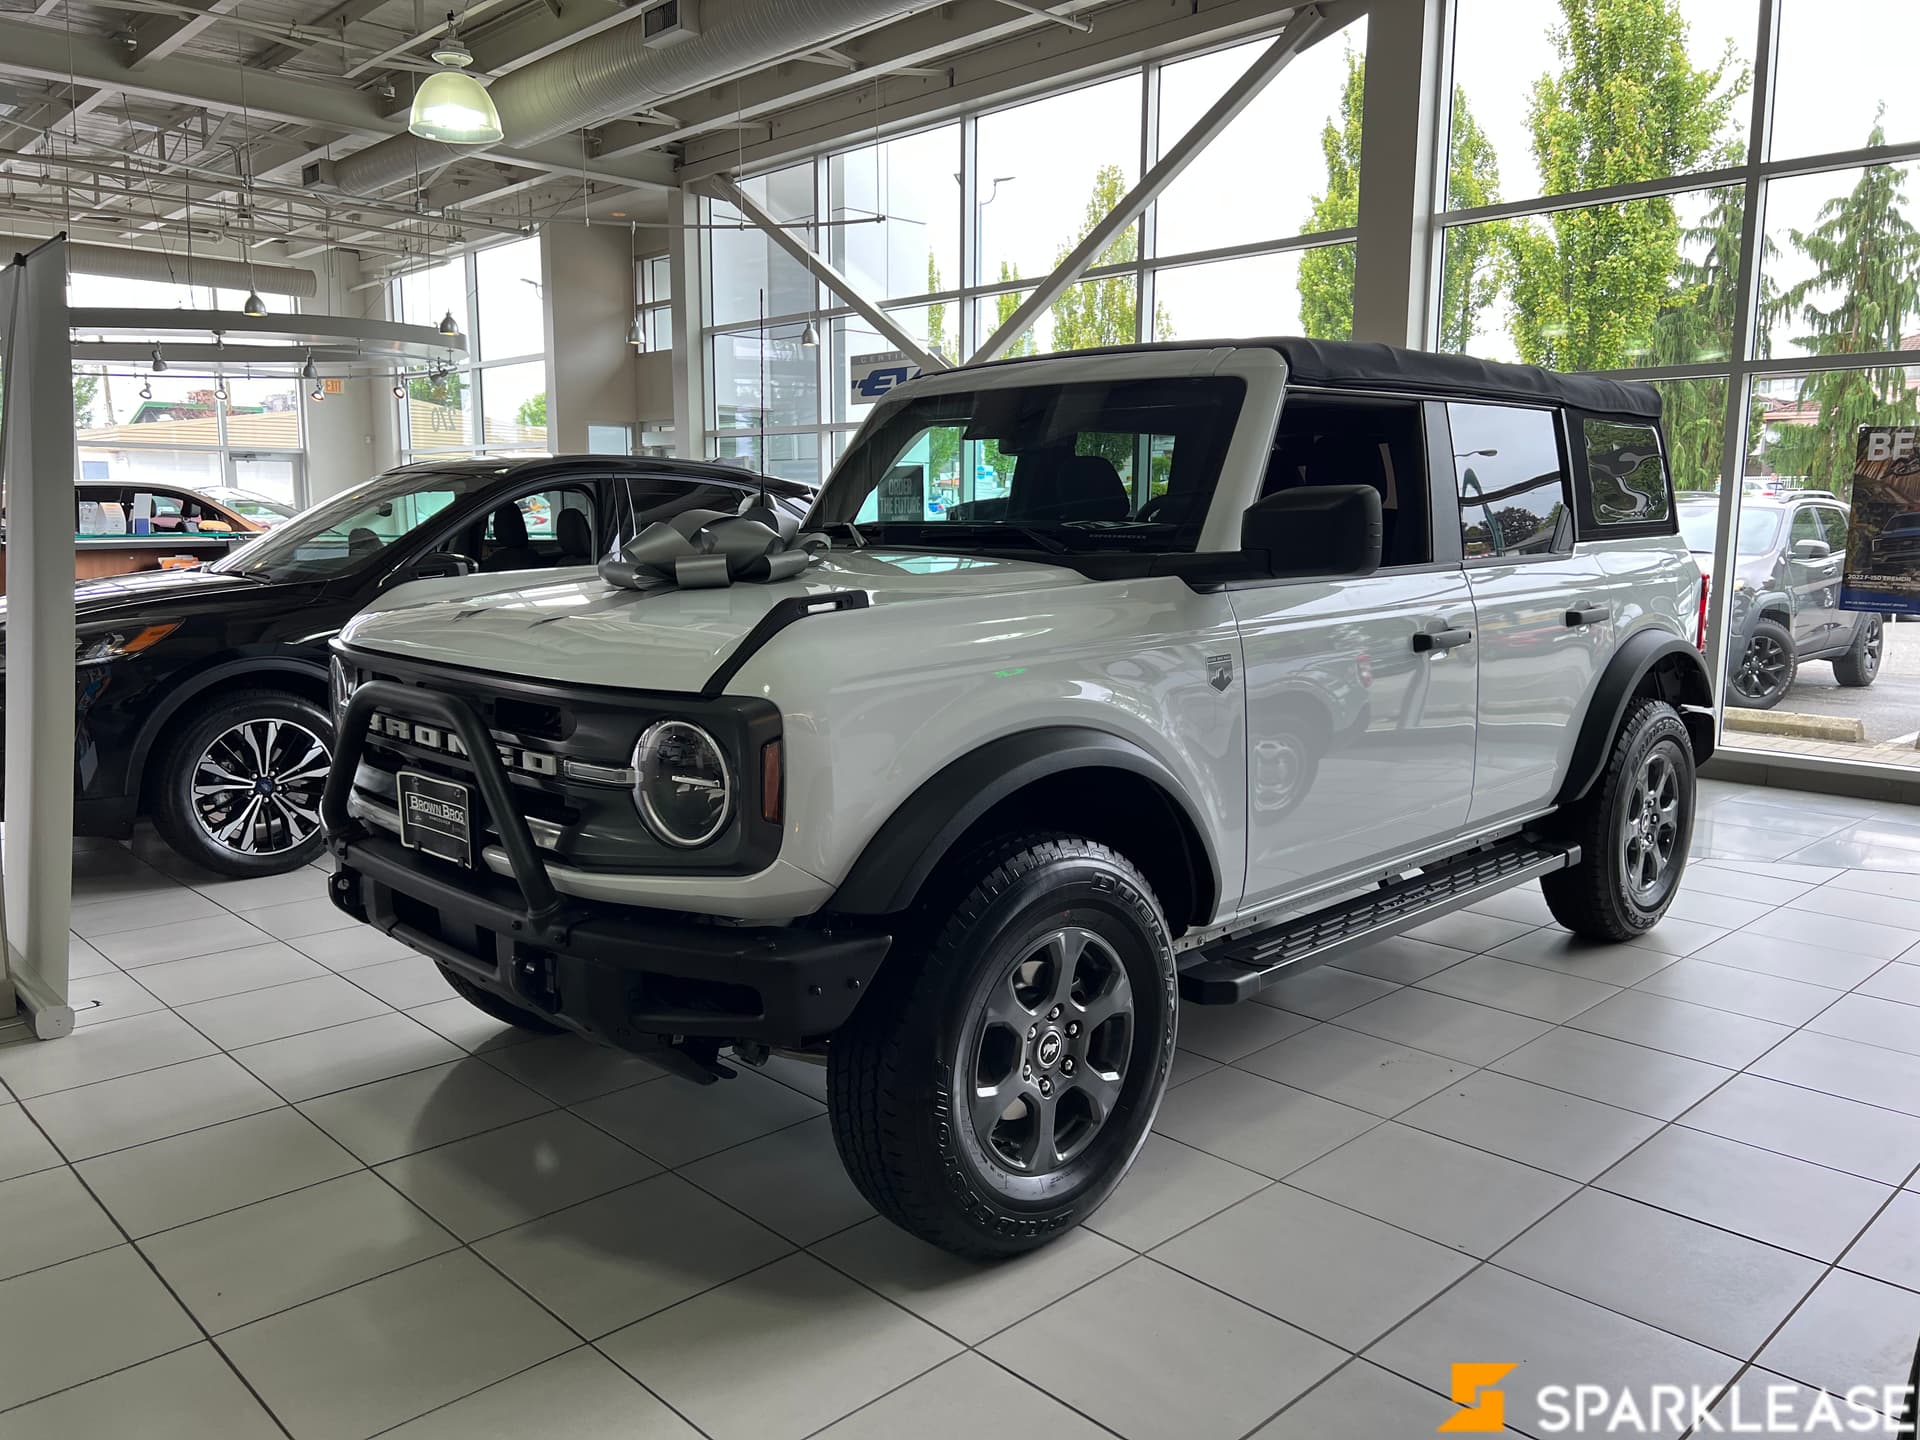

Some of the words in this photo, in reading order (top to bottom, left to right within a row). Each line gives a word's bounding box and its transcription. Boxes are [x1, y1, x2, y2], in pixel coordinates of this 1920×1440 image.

[888, 478, 913, 496] ORDER
[880, 496, 894, 514] THE
[894, 496, 921, 514] FUTURE
